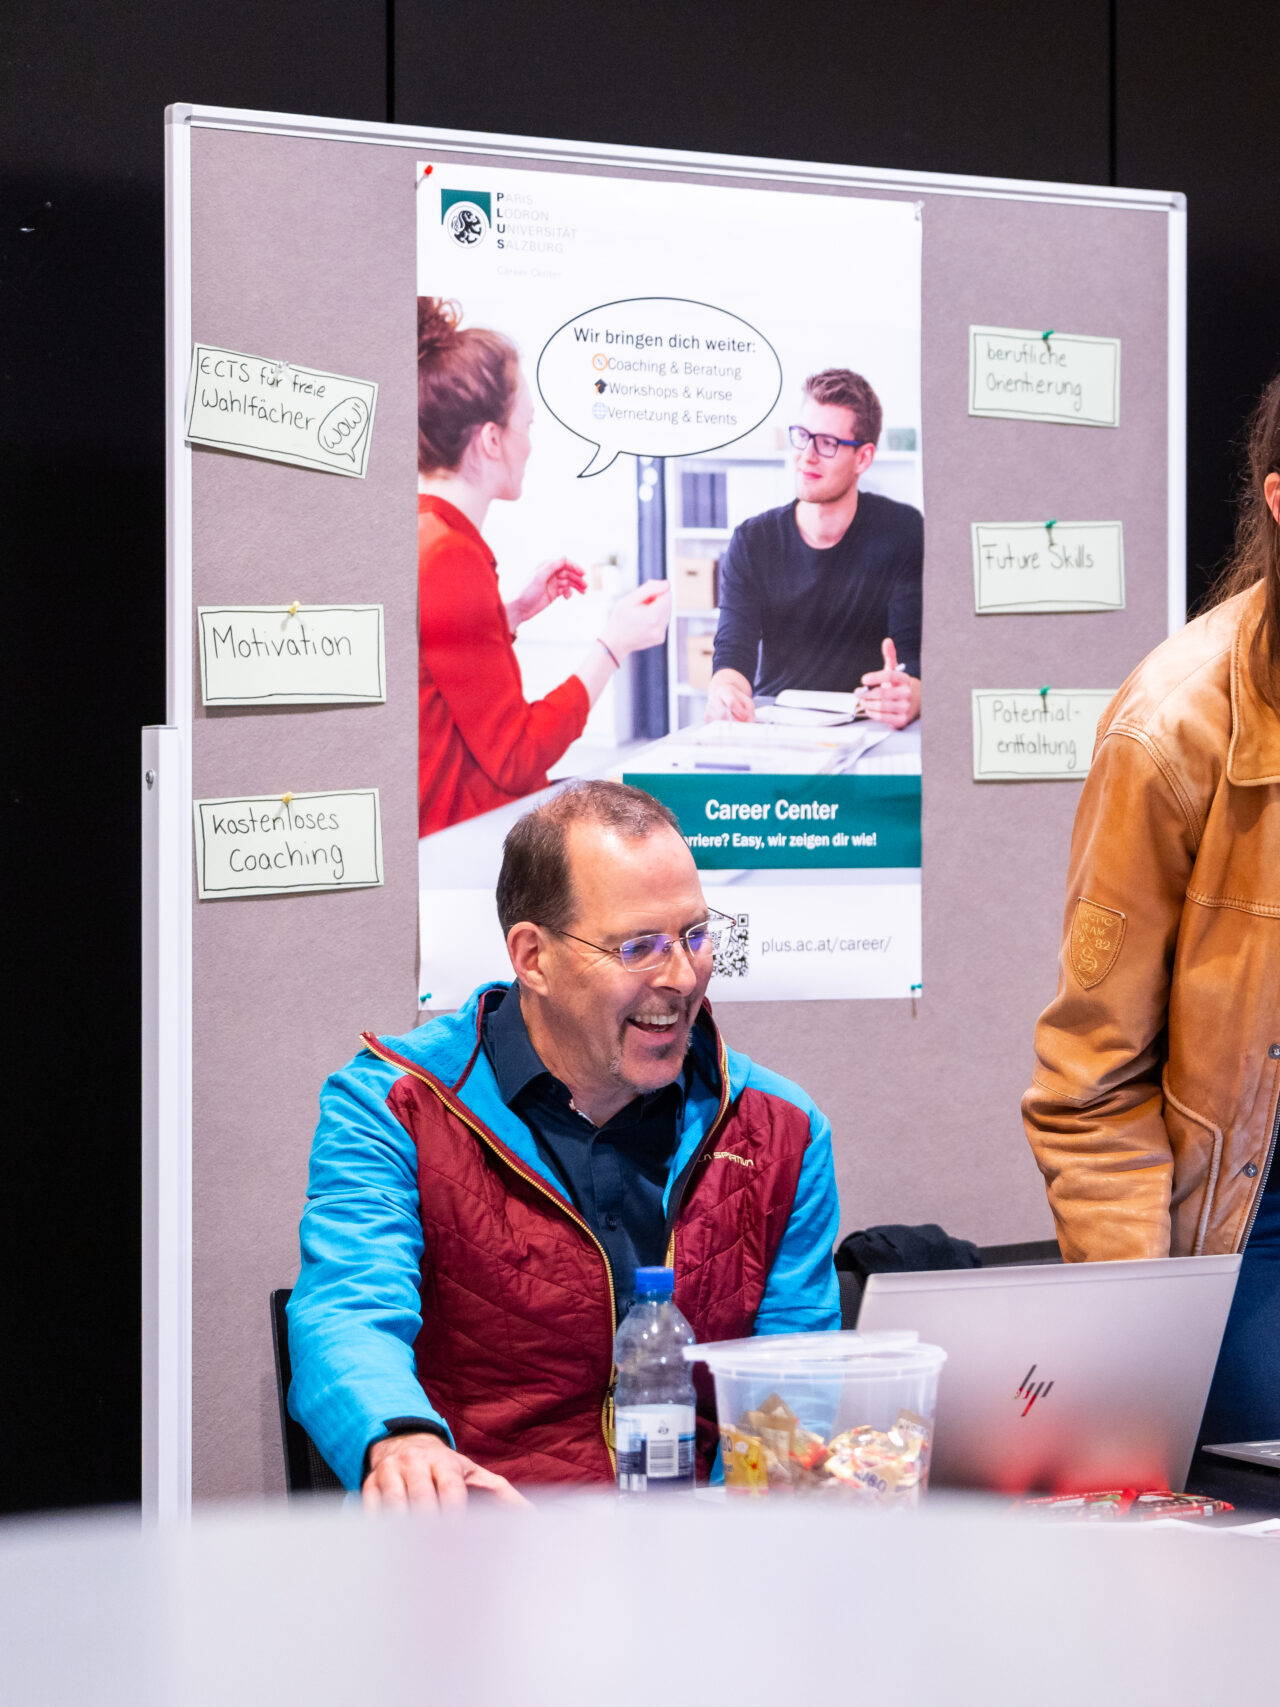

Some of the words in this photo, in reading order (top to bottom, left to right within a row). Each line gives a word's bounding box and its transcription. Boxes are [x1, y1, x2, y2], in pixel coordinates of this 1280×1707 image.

[496, 192, 533, 205] PARIS
[496, 207, 549, 221] LODRON
[496, 238, 564, 254] SALZBURG
[574, 327, 600, 343] Wir
[605, 329, 663, 349] bringen
[668, 334, 700, 350] dich
[705, 338, 756, 353] weiter:
[987, 341, 1068, 367] berufliche
[200, 356, 250, 383] ECTS
[260, 366, 284, 388] für
[292, 374, 327, 398] freie
[607, 357, 666, 376] Coaching
[670, 362, 679, 374] &
[684, 362, 742, 380] Beratung
[609, 382, 678, 399] Workshops
[683, 386, 692, 399] &
[696, 387, 732, 401] Kurse
[986, 372, 1083, 412] Orientierung
[201, 388, 317, 431] Wahlfächer
[608, 406, 678, 425] Vernetzung
[683, 410, 692, 423] &
[696, 411, 738, 425] Events
[982, 543, 1040, 569] Future
[1048, 543, 1095, 569] Skills
[212, 624, 352, 658] Motivation
[992, 699, 1080, 723] Potential-
[997, 732, 1077, 770] entfaltung
[705, 799, 771, 820] Career
[775, 799, 838, 820] Center
[684, 833, 729, 847] arriere?
[732, 833, 765, 850] Easy,
[767, 832, 787, 847] wir
[789, 833, 829, 850] zeigen
[832, 832, 849, 847] dir
[851, 832, 877, 847] wie!
[229, 841, 345, 880] Coaching
[761, 936, 892, 955] plus.ac.at/career/
